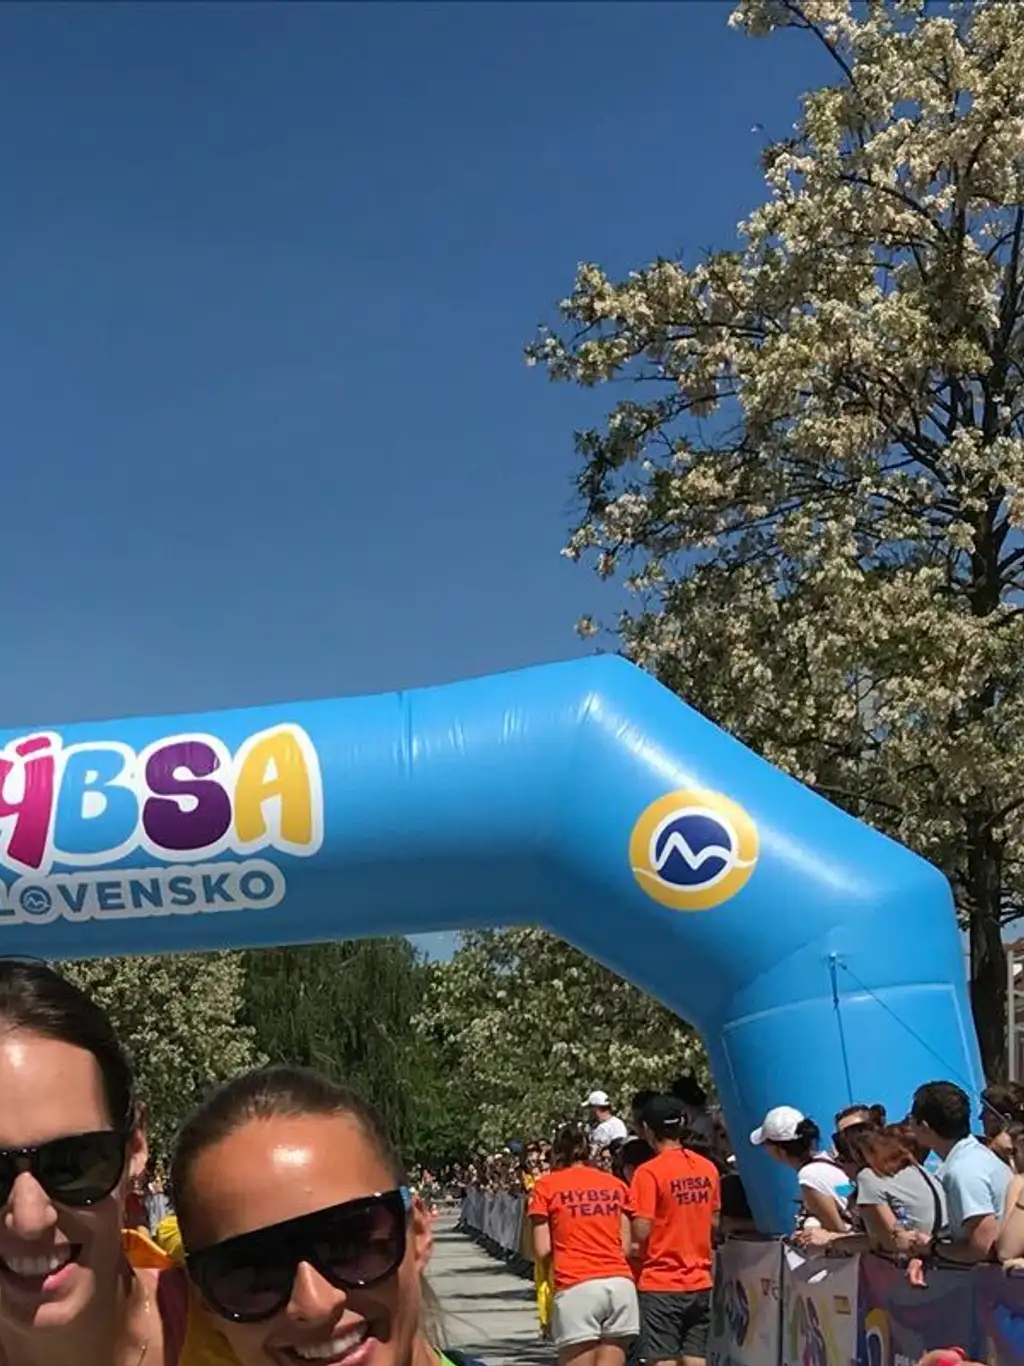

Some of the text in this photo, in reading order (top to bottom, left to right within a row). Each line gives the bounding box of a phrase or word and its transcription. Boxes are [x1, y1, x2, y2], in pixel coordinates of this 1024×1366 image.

[560, 1189, 622, 1205] HYBSA
[676, 1190, 709, 1206] TEAM
[567, 1202, 619, 1218] TEAM
